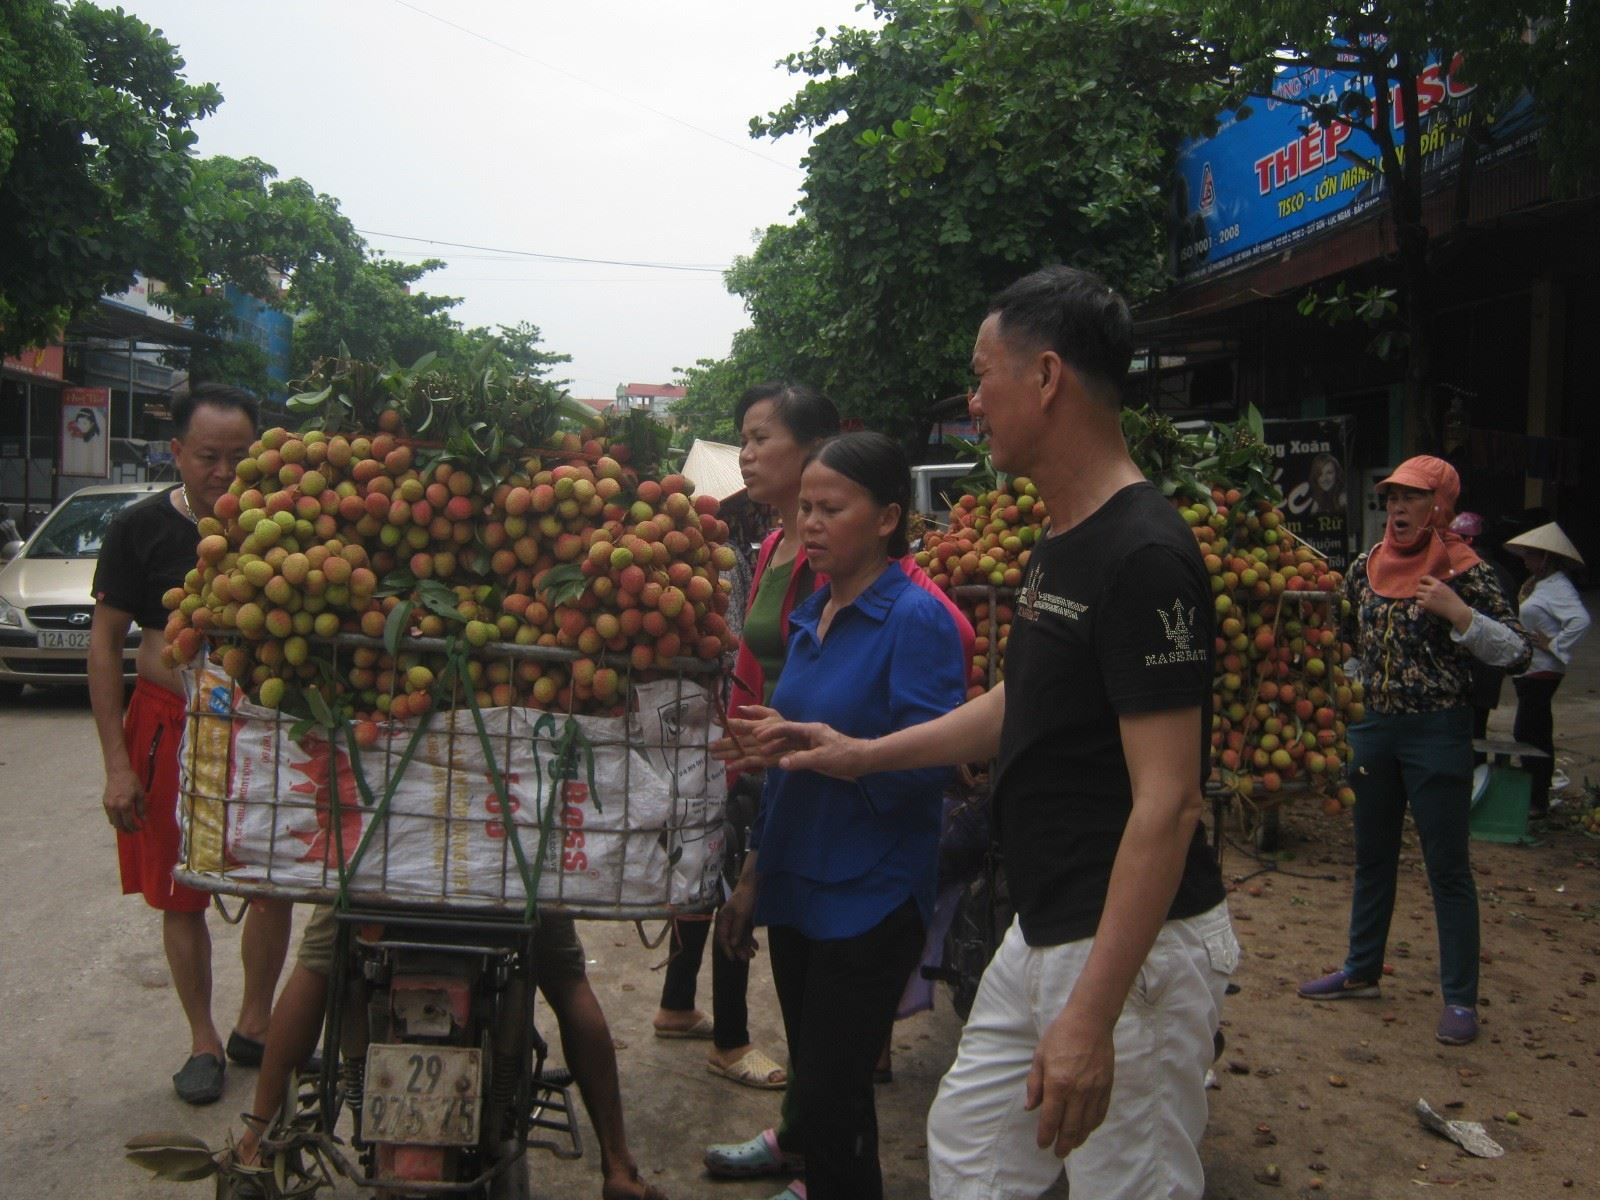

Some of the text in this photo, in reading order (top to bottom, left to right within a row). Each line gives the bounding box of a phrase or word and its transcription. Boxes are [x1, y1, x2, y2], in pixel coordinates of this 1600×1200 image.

[1254, 117, 1353, 196] THÉP
[1278, 191, 1305, 219] TISCO
[1314, 174, 1337, 203] LỚN
[1219, 223, 1240, 244] 2008
[1144, 649, 1207, 667] MASERATI
[407, 1054, 442, 1094] 29
